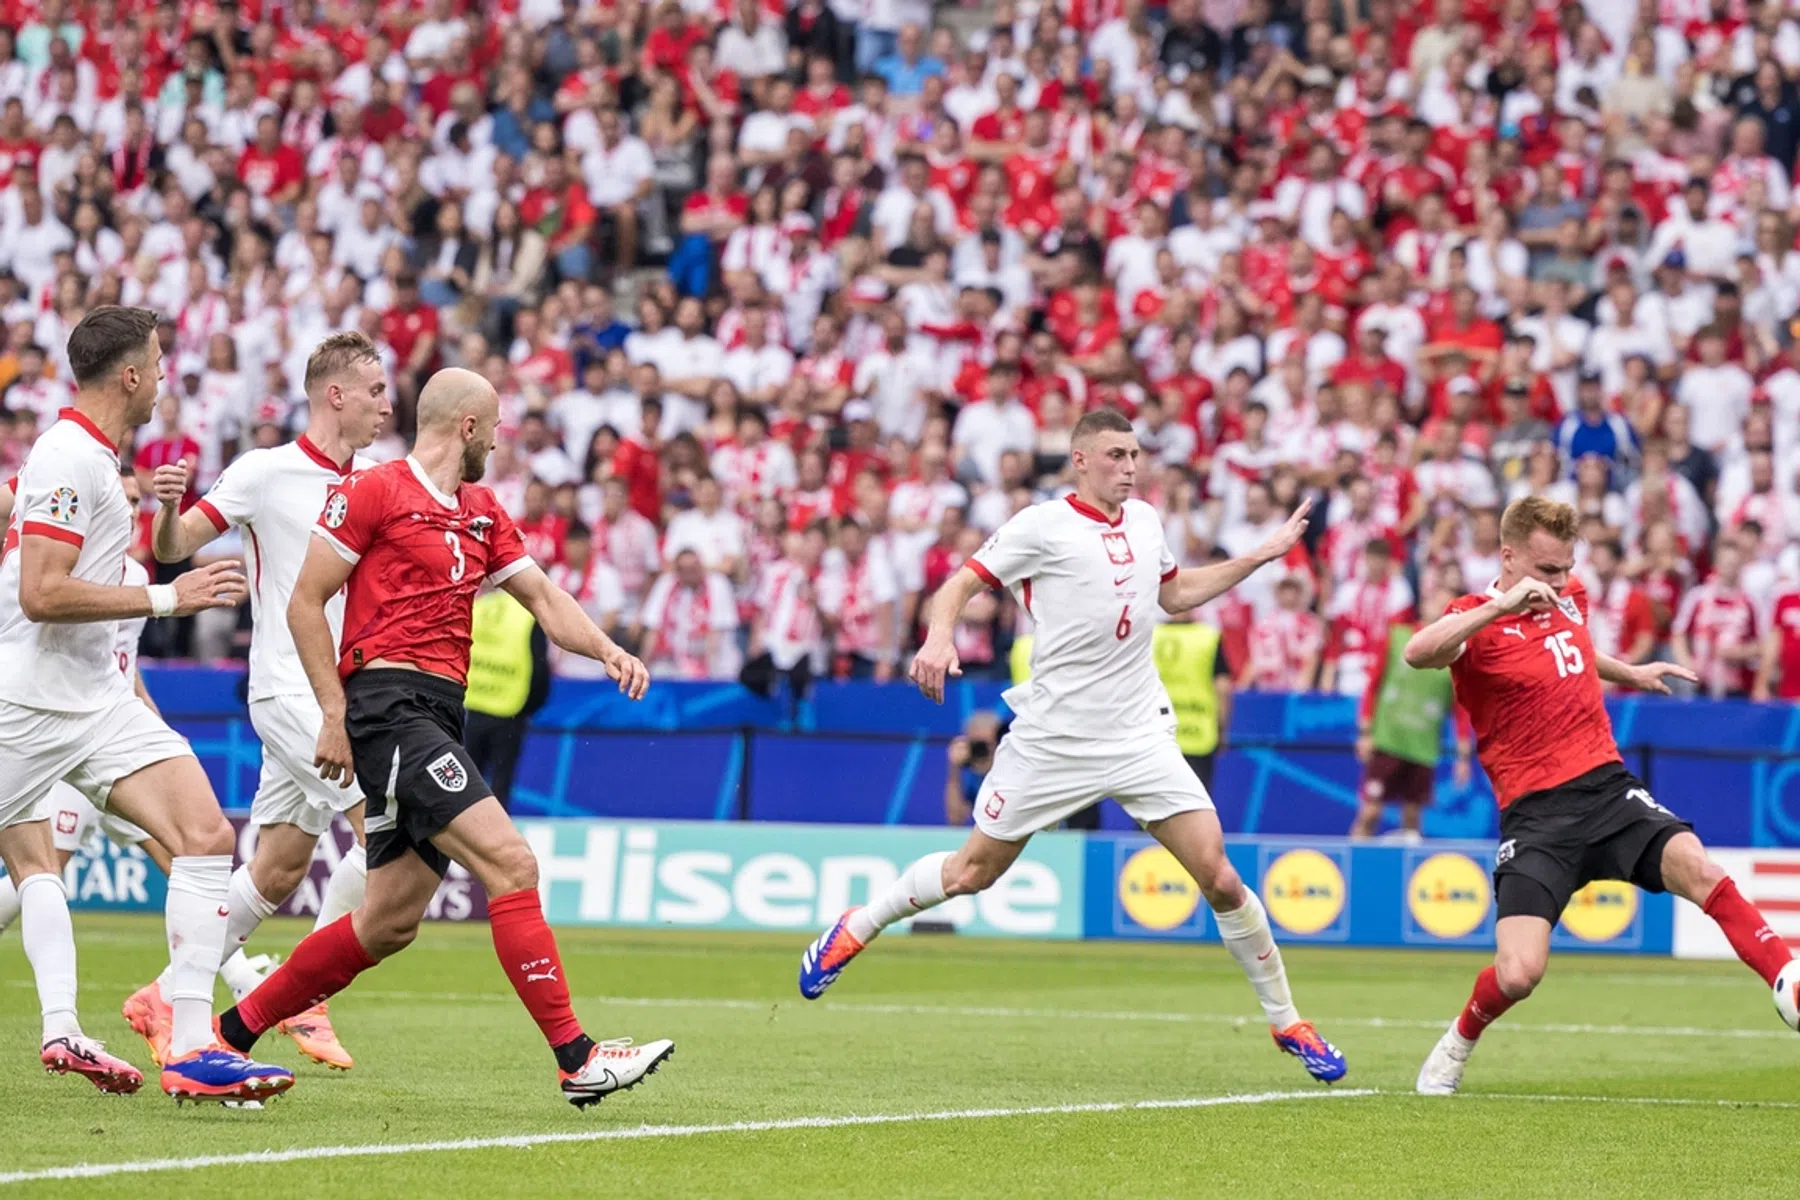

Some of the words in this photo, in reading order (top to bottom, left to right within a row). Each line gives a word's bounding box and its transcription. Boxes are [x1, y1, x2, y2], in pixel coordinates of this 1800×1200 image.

[445, 530, 466, 582] 3
[1115, 604, 1132, 641] 6
[1543, 630, 1585, 679] 15
[62, 857, 149, 904] TAR
